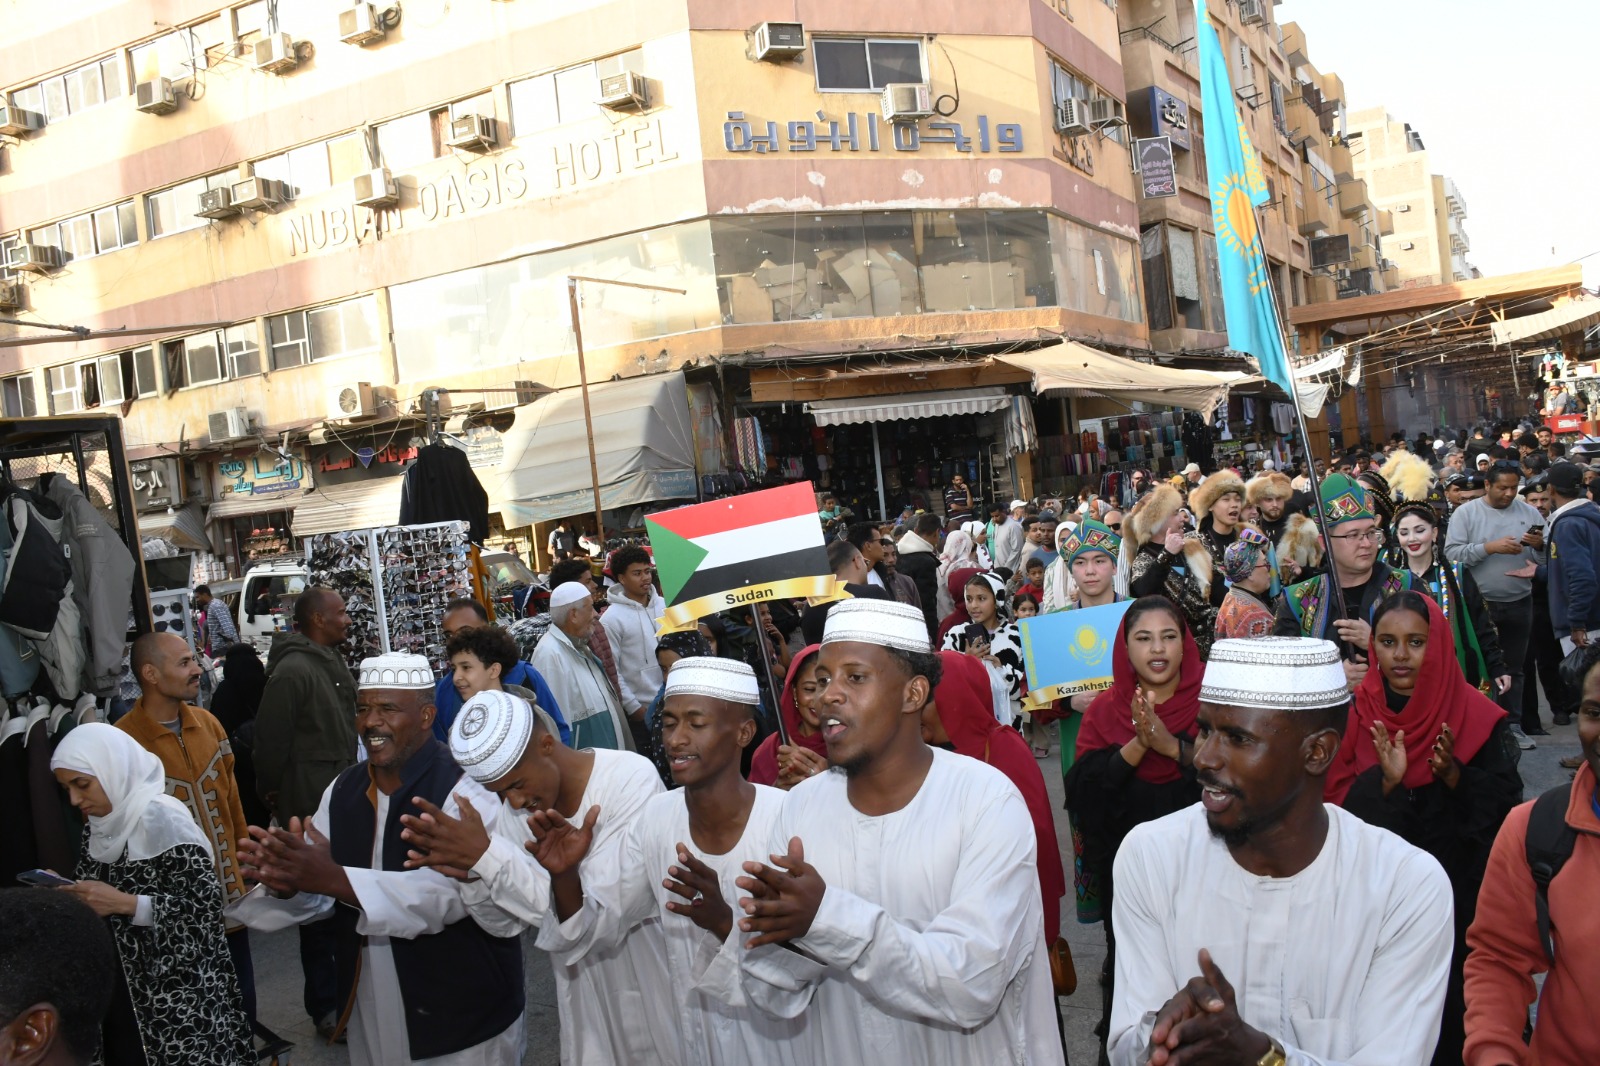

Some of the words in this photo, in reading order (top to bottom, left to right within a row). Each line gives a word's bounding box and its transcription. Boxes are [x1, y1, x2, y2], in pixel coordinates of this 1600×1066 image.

[723, 109, 880, 155] النوبية
[417, 158, 528, 222] OASIS
[552, 117, 680, 189] HOTEL
[725, 588, 774, 605] Sudan
[1056, 680, 1115, 696] Kazakhsta
